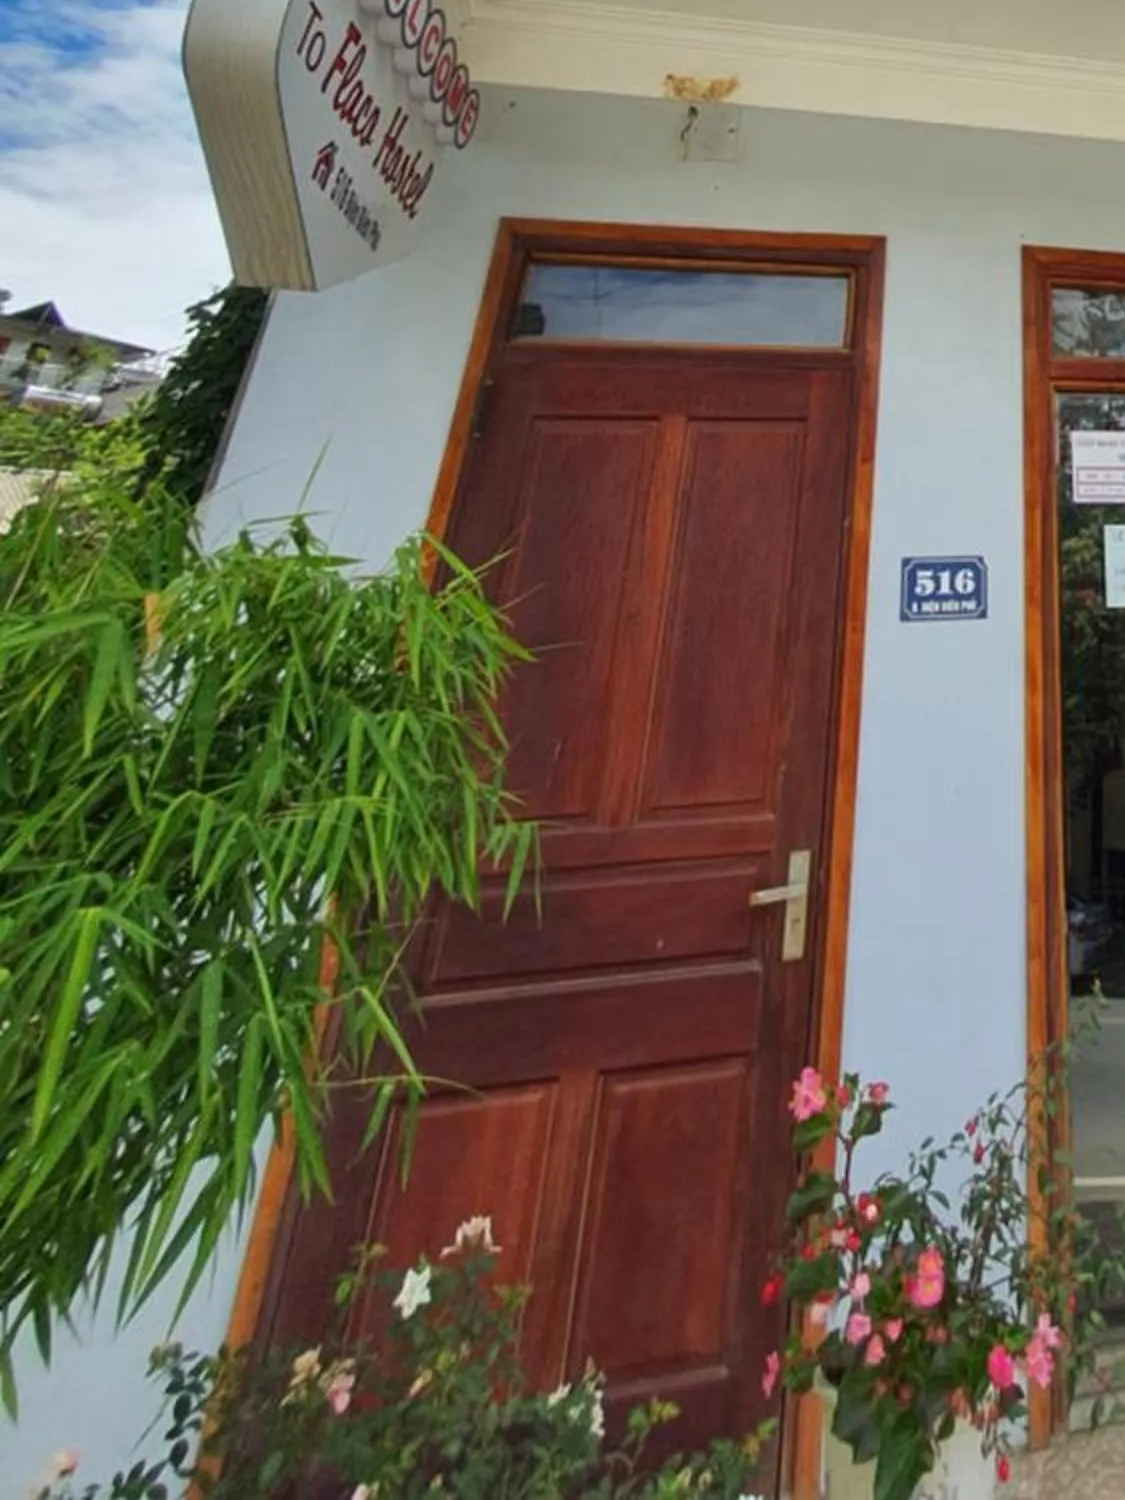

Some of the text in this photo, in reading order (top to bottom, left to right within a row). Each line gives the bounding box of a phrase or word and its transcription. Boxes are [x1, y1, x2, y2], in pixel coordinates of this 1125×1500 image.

[321, 20, 381, 147] Flaco
[372, 105, 435, 220] Hostel
[913, 568, 975, 596] 516
